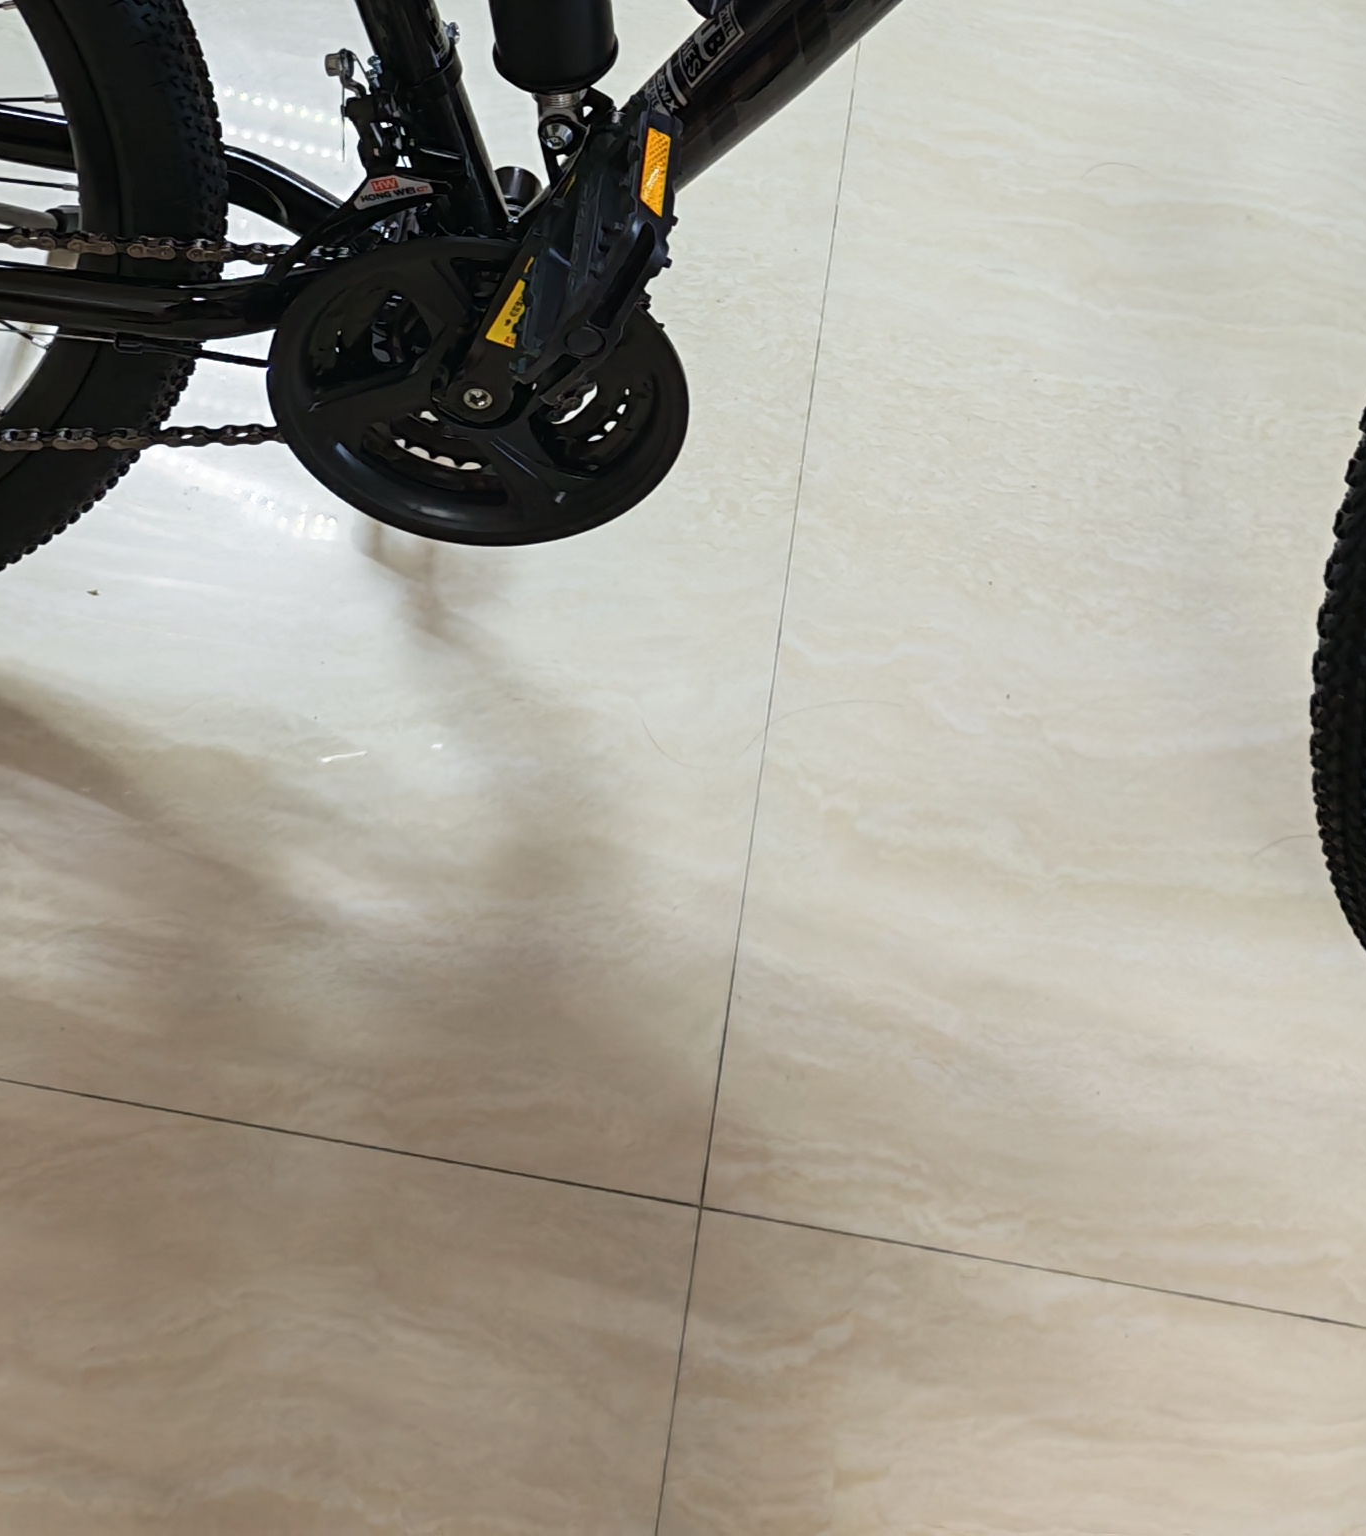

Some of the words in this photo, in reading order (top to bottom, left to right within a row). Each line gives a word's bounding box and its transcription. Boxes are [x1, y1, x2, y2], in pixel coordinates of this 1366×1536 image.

[372, 179, 398, 191] HW
[360, 191, 392, 204] HONG
[393, 187, 418, 199] WEI
